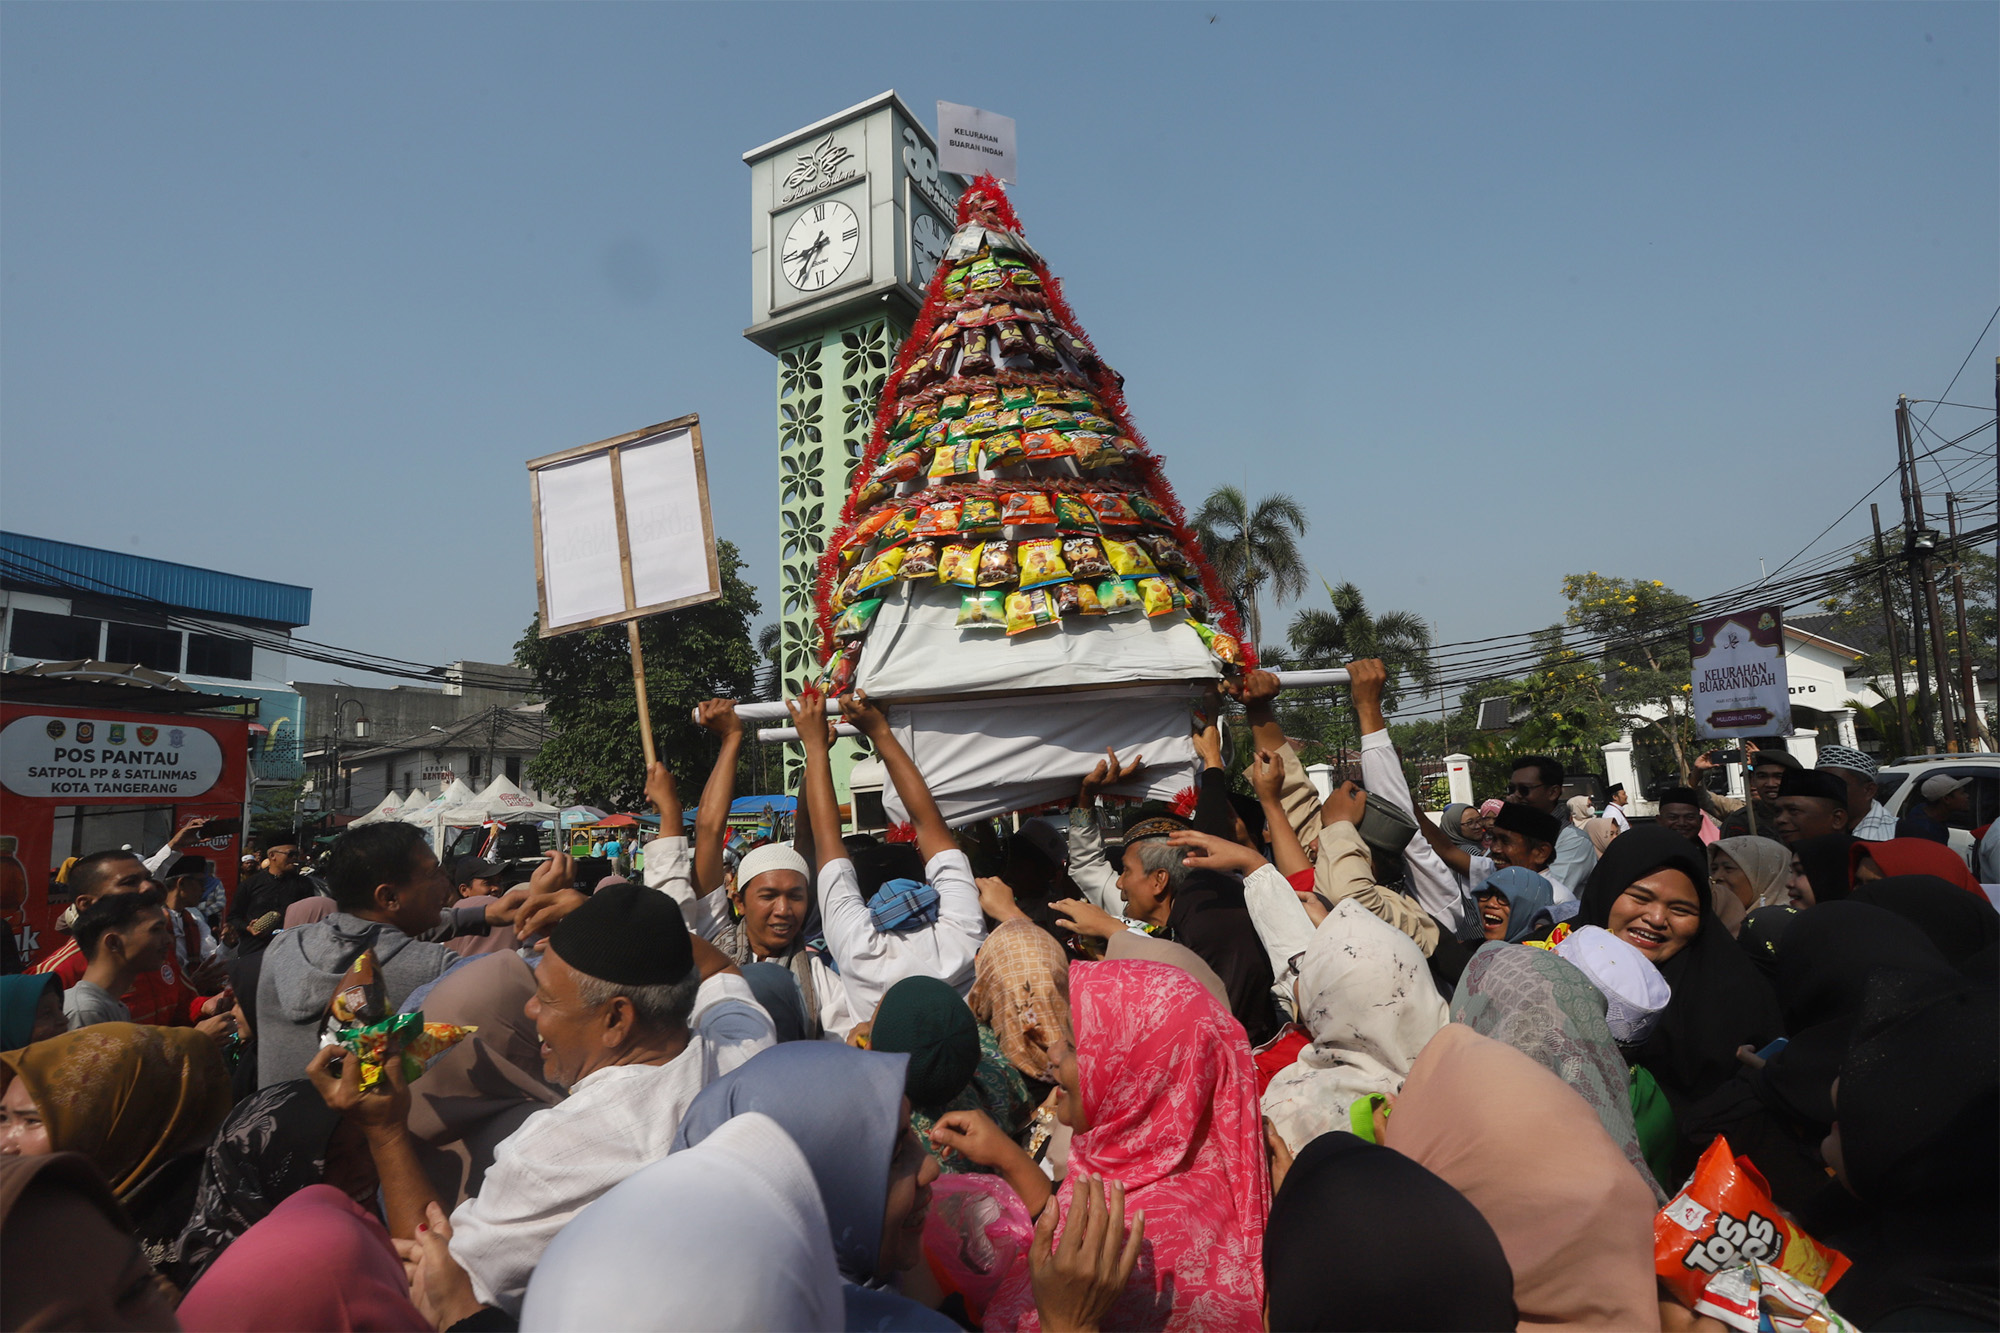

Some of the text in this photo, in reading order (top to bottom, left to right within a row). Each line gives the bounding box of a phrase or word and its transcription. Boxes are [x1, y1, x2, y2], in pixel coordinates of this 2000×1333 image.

[954, 127, 999, 144] KELURAHAN
[949, 140, 1004, 157] BUARAN INDAH
[935, 178, 957, 207] ARG
[927, 183, 957, 225] PANT
[1704, 662, 1767, 682] KELURAHAN
[1699, 673, 1776, 693] BUARAN INDAH
[1788, 685, 1816, 695] OPO
[54, 747, 179, 766] POS PANTAU
[28, 767, 197, 781] SATPOL PP & SATLINMAS
[51, 782, 178, 794] KOTA TANGERANG
[1684, 1214, 1747, 1273] TOS
